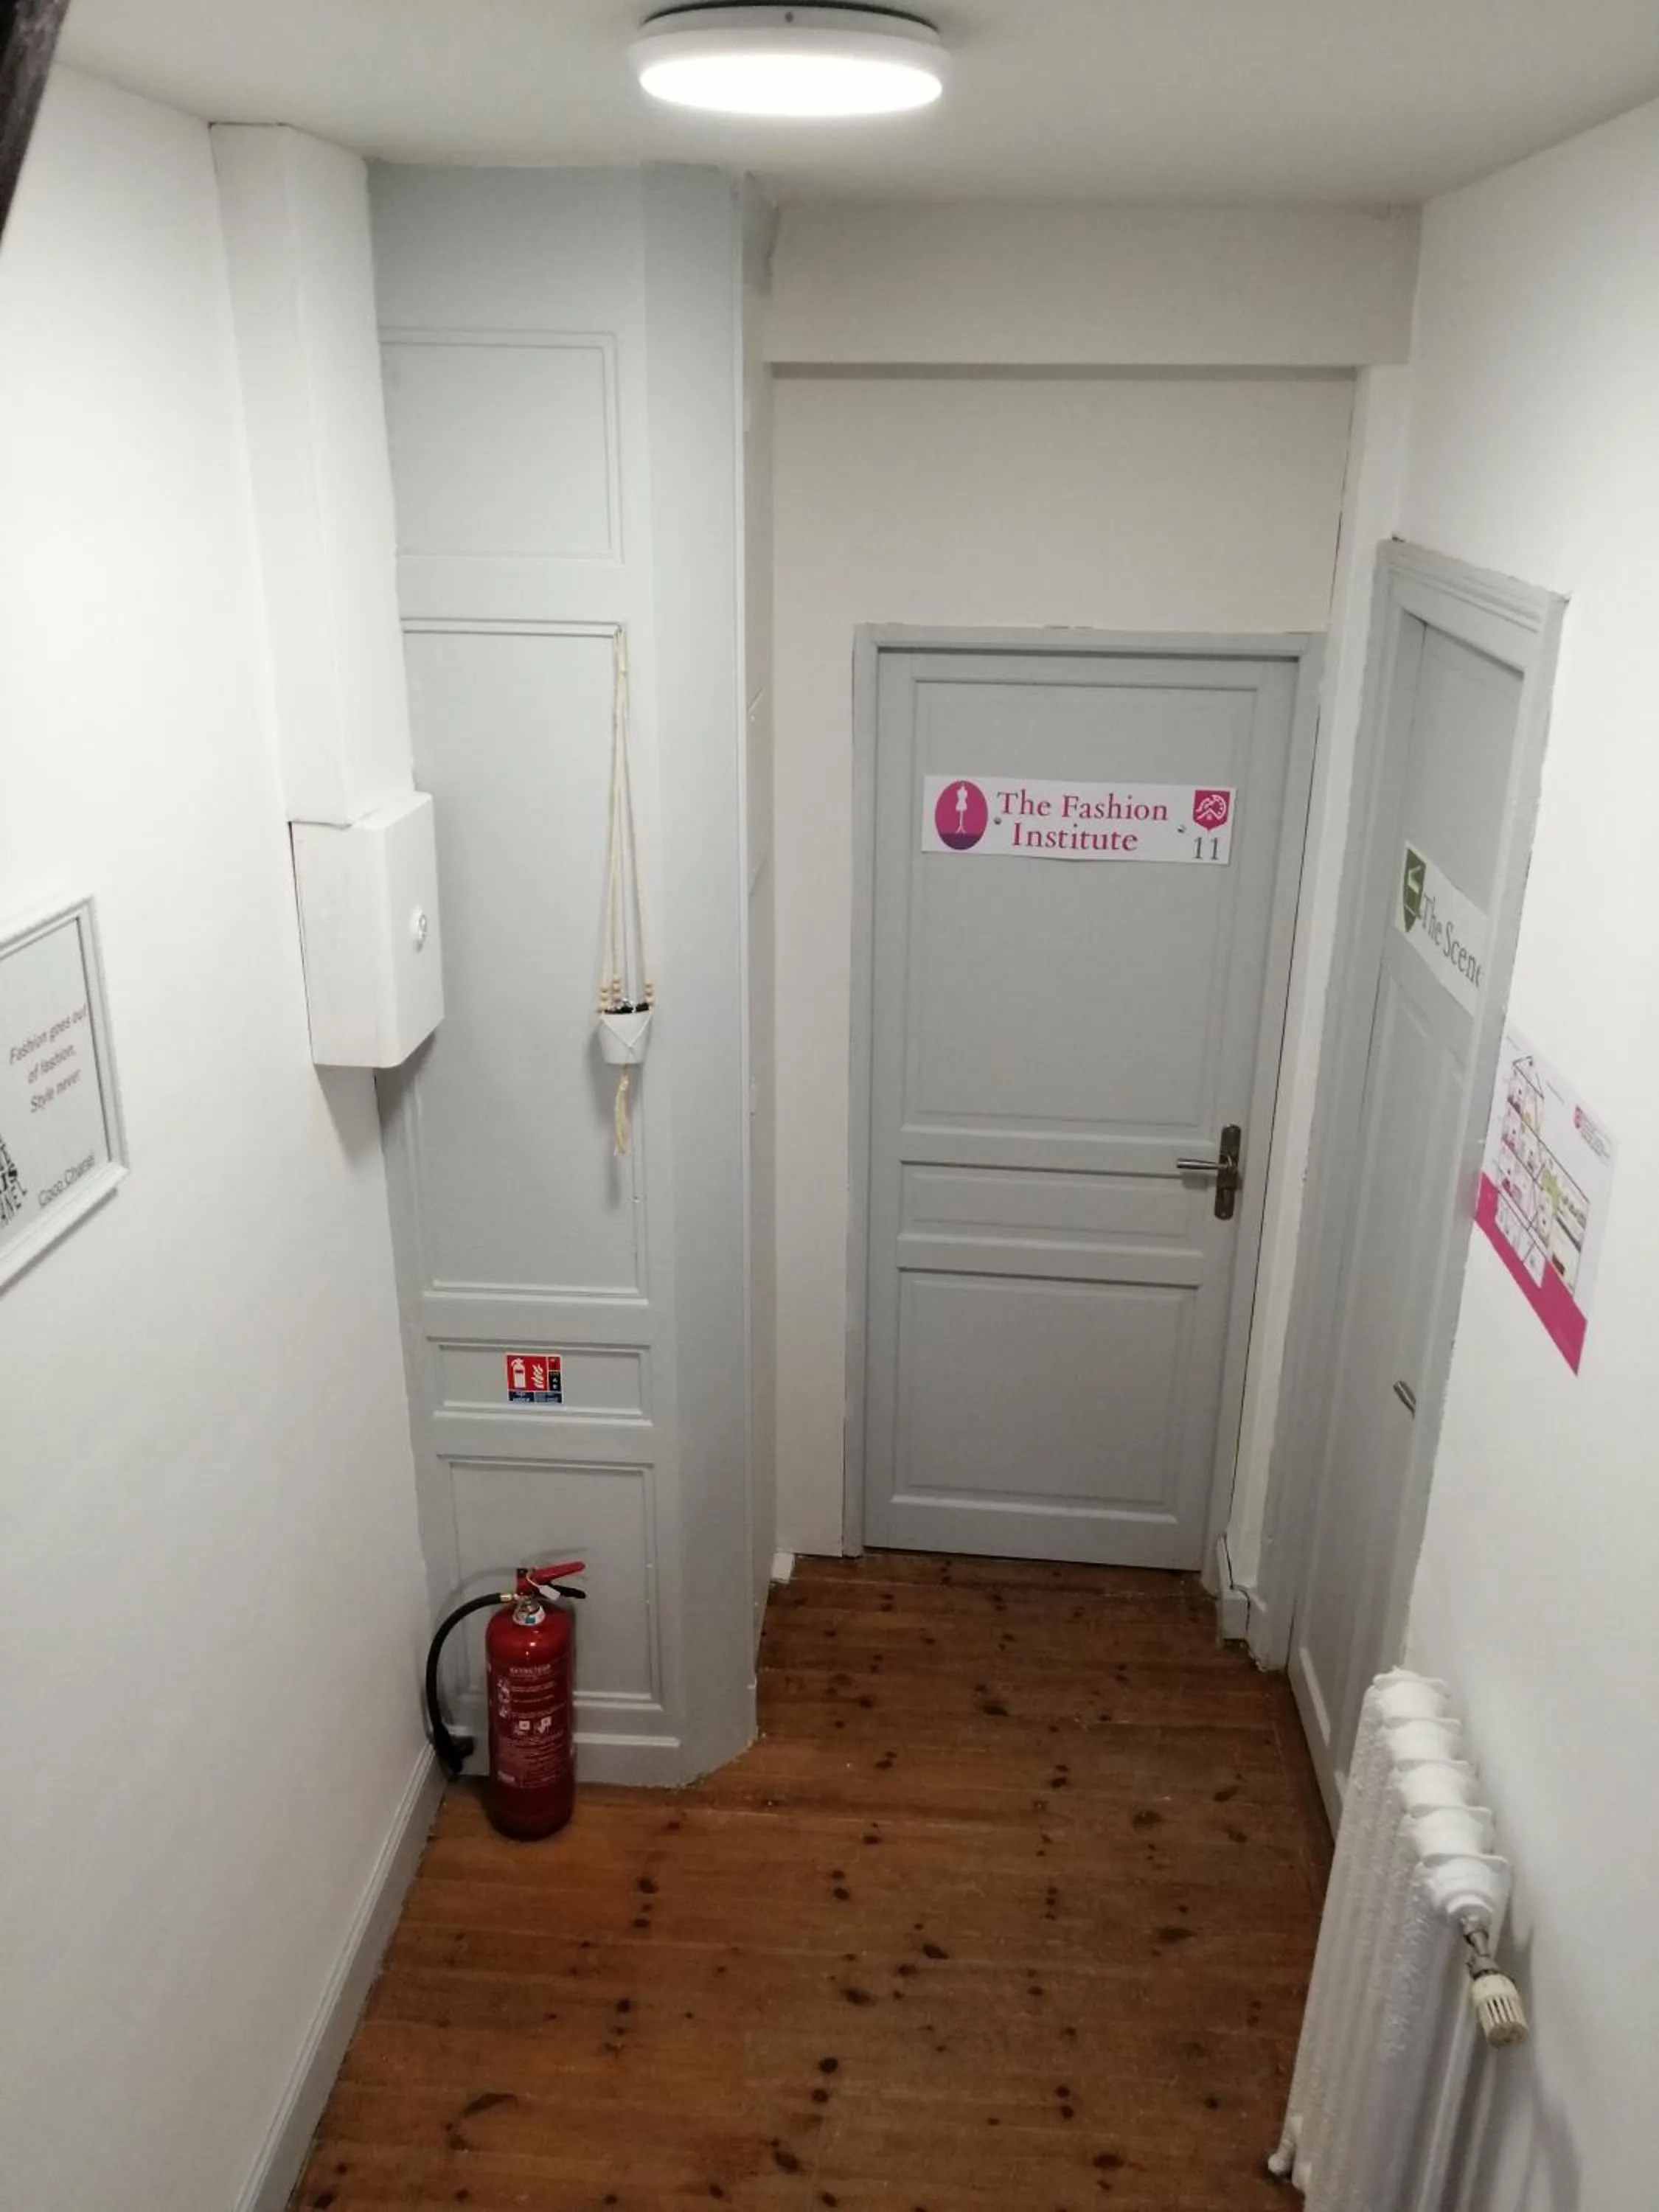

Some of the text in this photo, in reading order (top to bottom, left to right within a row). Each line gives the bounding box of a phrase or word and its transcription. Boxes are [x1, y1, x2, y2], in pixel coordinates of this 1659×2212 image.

[997, 788, 1169, 821] The Fashion
[1012, 822, 1138, 851] Institute
[1194, 837, 1219, 860] 11
[1423, 894, 1481, 989] The Scent
